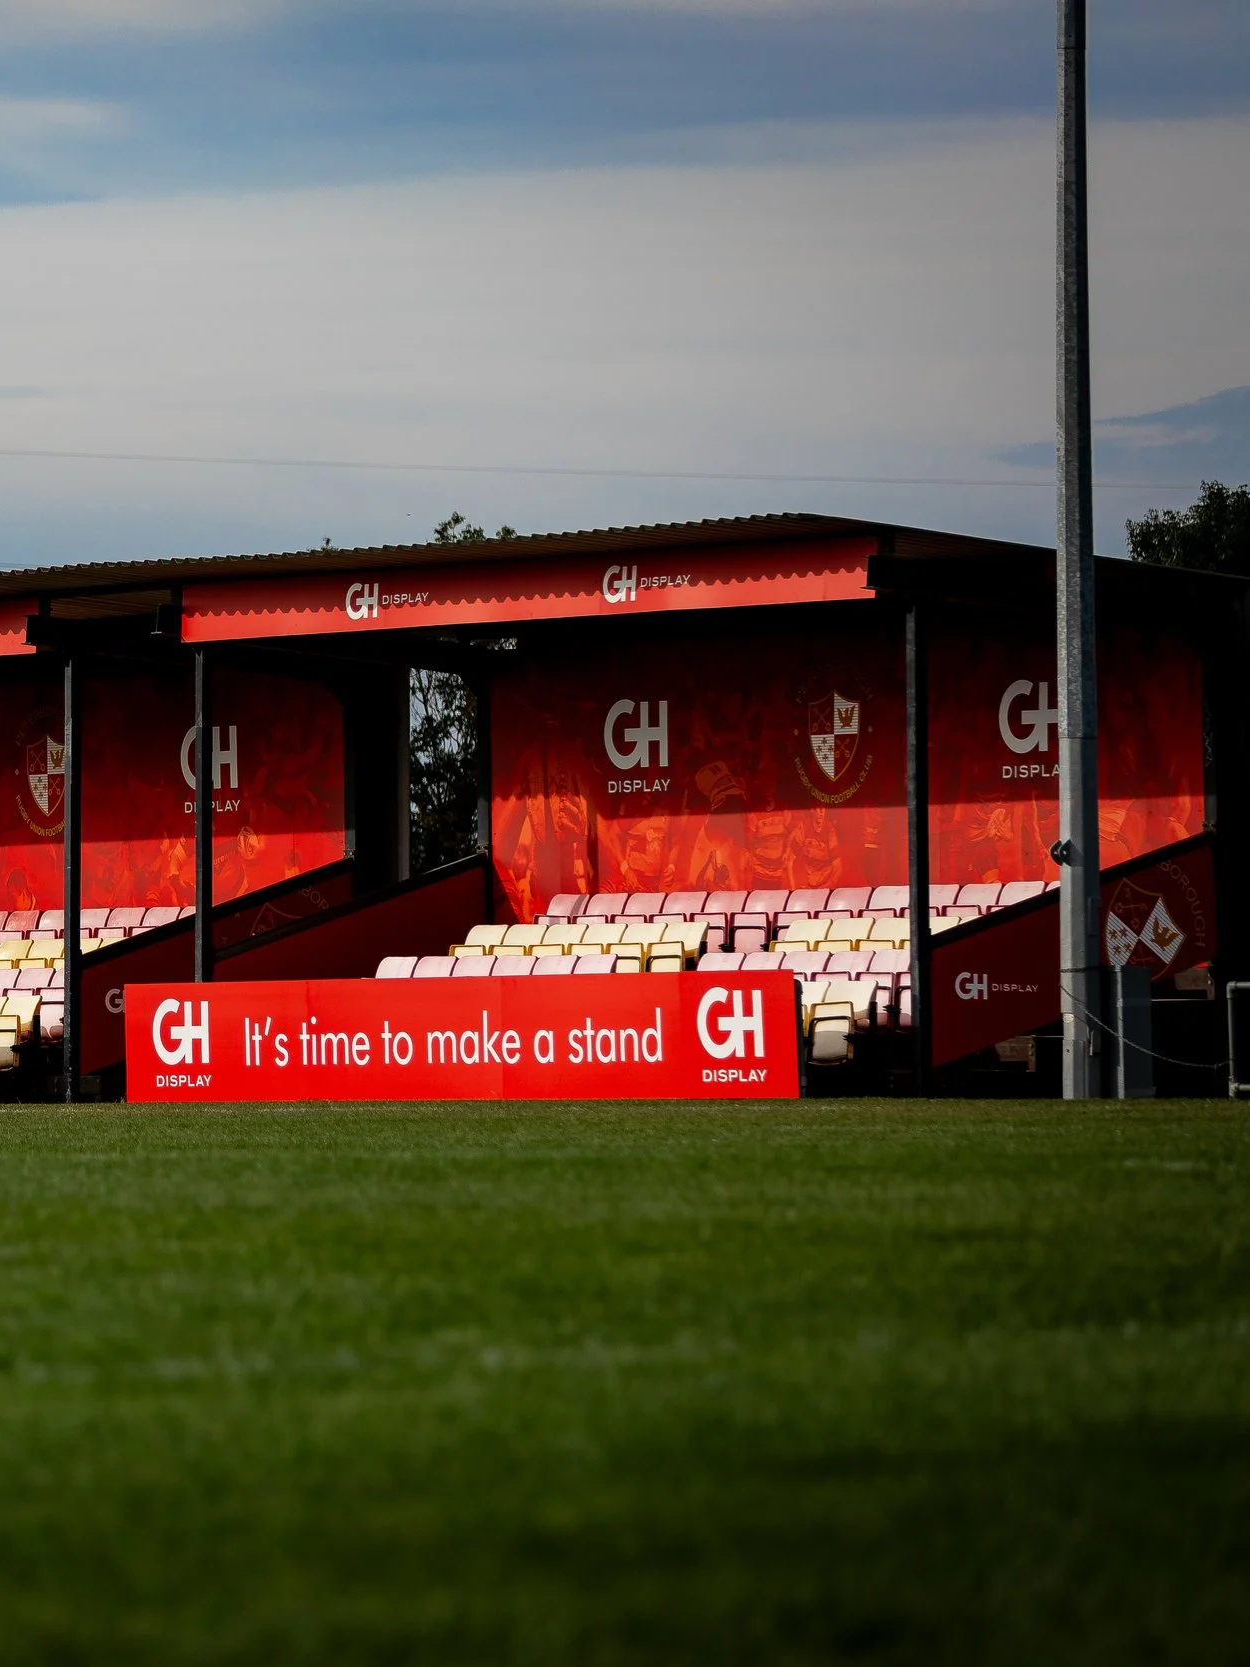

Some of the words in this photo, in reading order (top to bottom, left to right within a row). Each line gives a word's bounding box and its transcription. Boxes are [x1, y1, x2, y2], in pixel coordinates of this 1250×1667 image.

[602, 565, 638, 604] GH
[639, 574, 692, 588] DISPLAY
[345, 582, 379, 621] GH
[381, 592, 430, 605] DISPLAY
[603, 699, 669, 770] GH
[608, 779, 671, 794] DISPLAY
[1002, 764, 1060, 779] DISPLA
[184, 799, 241, 814] DIPLAY
[830, 781, 861, 804] FOOTBALL
[954, 971, 989, 1001] GH
[991, 983, 1039, 993] DISPLAY
[151, 998, 210, 1066] GH
[244, 1016, 289, 1067] It's
[299, 1015, 371, 1066] time
[381, 1020, 414, 1066] to
[426, 1009, 521, 1065] make
[533, 1029, 555, 1064] a
[568, 1007, 663, 1064] stand
[696, 986, 765, 1060] GH
[156, 1074, 212, 1088] DISPLAY
[702, 1069, 768, 1083] DISPLAY
